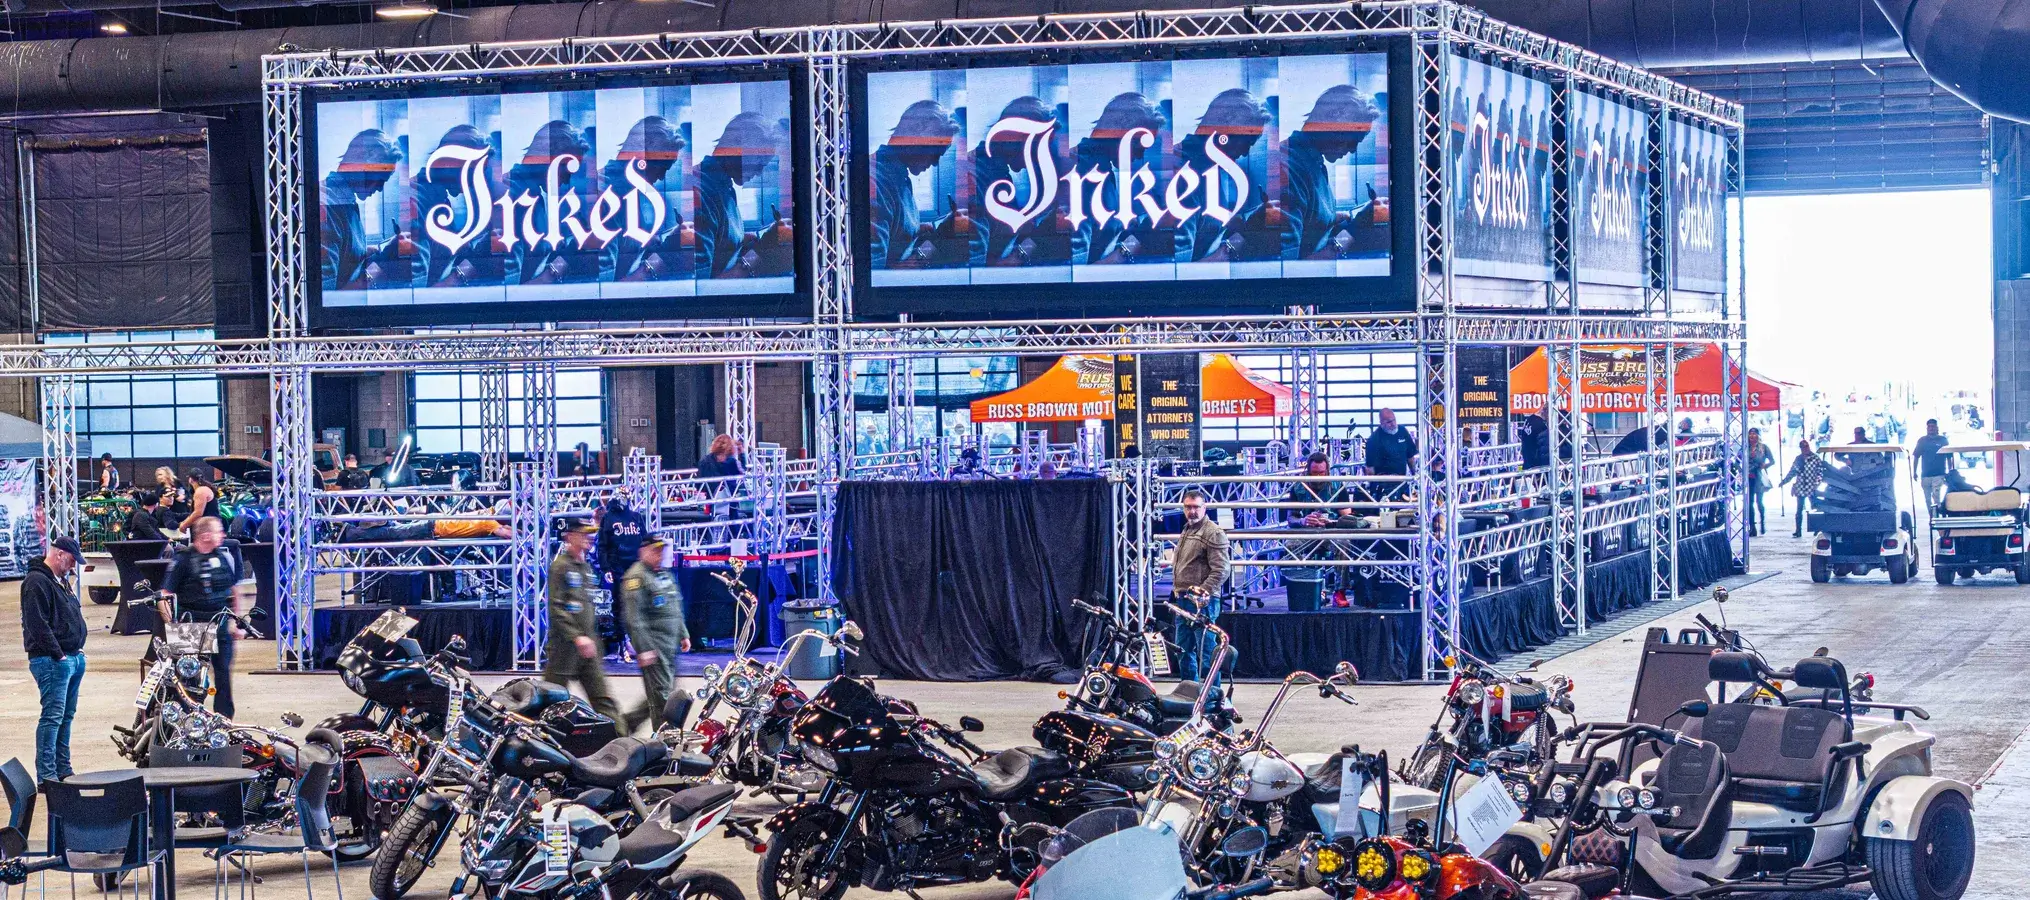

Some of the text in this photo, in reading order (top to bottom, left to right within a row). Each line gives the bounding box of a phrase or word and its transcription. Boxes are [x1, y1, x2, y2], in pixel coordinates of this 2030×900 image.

[985, 117, 1249, 233] Inked
[1473, 111, 1529, 231] Inked
[1591, 139, 1632, 242] Inked
[425, 145, 665, 255] Inked
[1679, 162, 1715, 254] Inked
[1120, 375, 1133, 391] WE
[1162, 380, 1179, 391] THE
[1473, 375, 1489, 386] THE
[1118, 393, 1136, 410] CARE
[1151, 397, 1188, 407] ORIGINAL
[1463, 391, 1498, 402] ORIGINAL
[988, 403, 1023, 419] RUSS
[1027, 402, 1078, 418] BROWN
[1147, 413, 1194, 423] ATTORNEYS
[1459, 407, 1503, 418] ATTORNEYS
[1121, 423, 1134, 440] WE
[1151, 428, 1190, 439] WHO RIDE
[612, 521, 641, 537] Inke
